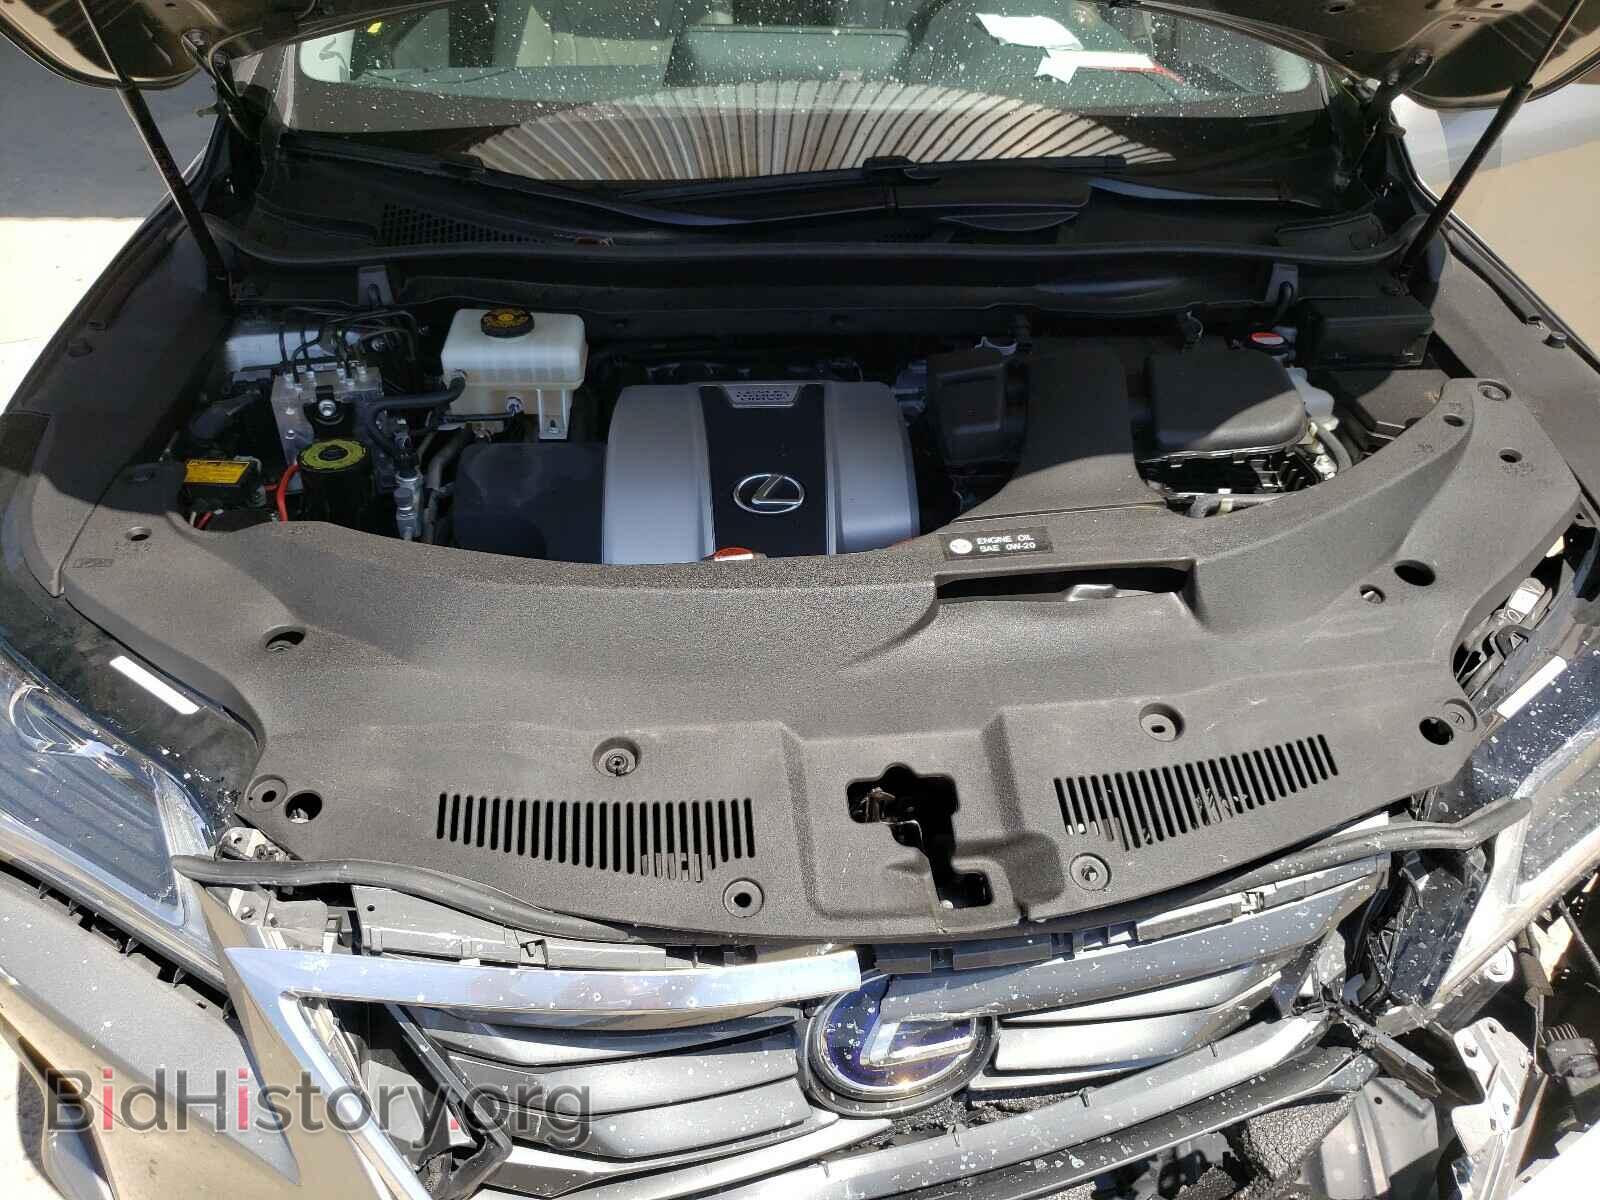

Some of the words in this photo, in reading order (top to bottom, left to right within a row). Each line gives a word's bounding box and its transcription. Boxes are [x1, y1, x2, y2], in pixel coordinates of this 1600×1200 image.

[976, 535, 1012, 545] ENGINE
[979, 544, 1000, 553] SAE
[1006, 542, 1036, 550] 0W-20
